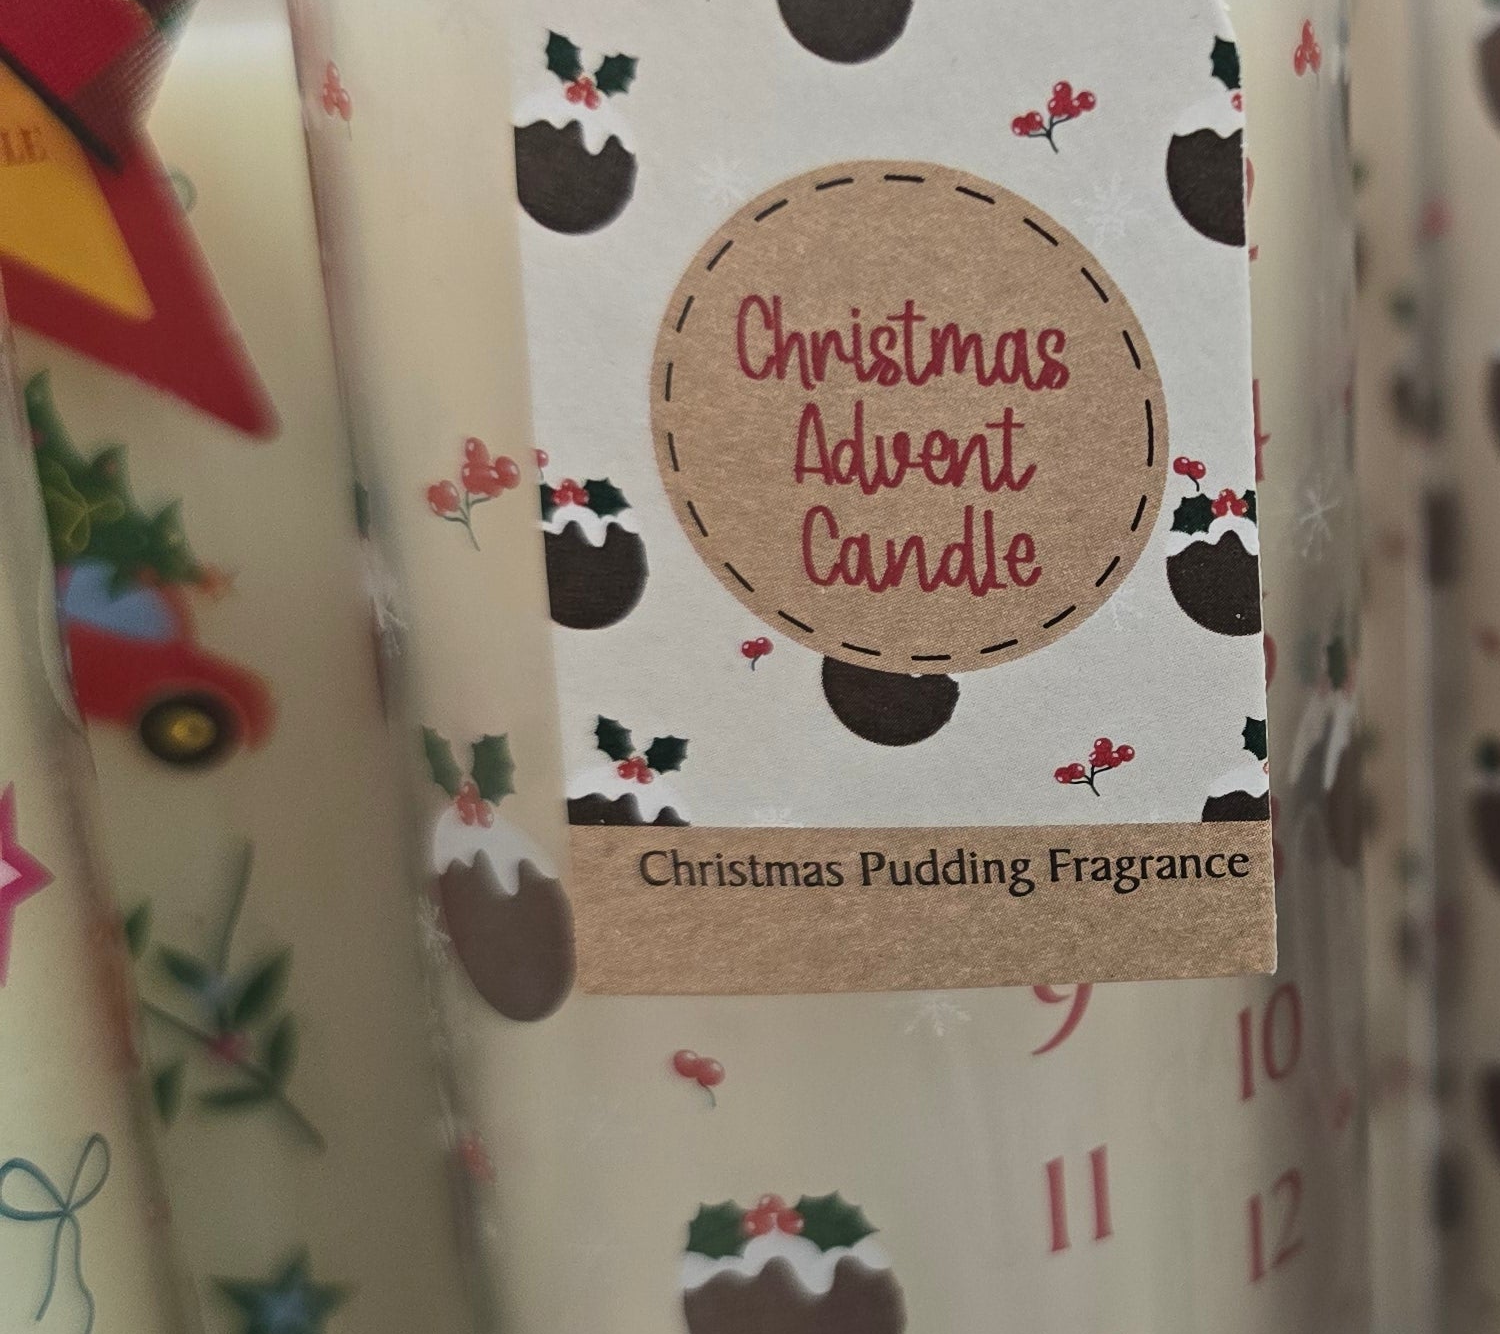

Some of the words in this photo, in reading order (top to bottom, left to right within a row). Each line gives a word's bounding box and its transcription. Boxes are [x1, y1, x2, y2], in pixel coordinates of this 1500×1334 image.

[736, 296, 1069, 390] Christmas
[794, 401, 1038, 494] Advent
[802, 506, 1042, 597] Candle
[639, 850, 844, 889] Christmas
[861, 850, 1035, 897] Pudding
[1049, 847, 1250, 892] Fragrance
[1237, 980, 1304, 1102] 10
[1045, 1144, 1112, 1254] 11
[1244, 1169, 1304, 1283] 12
